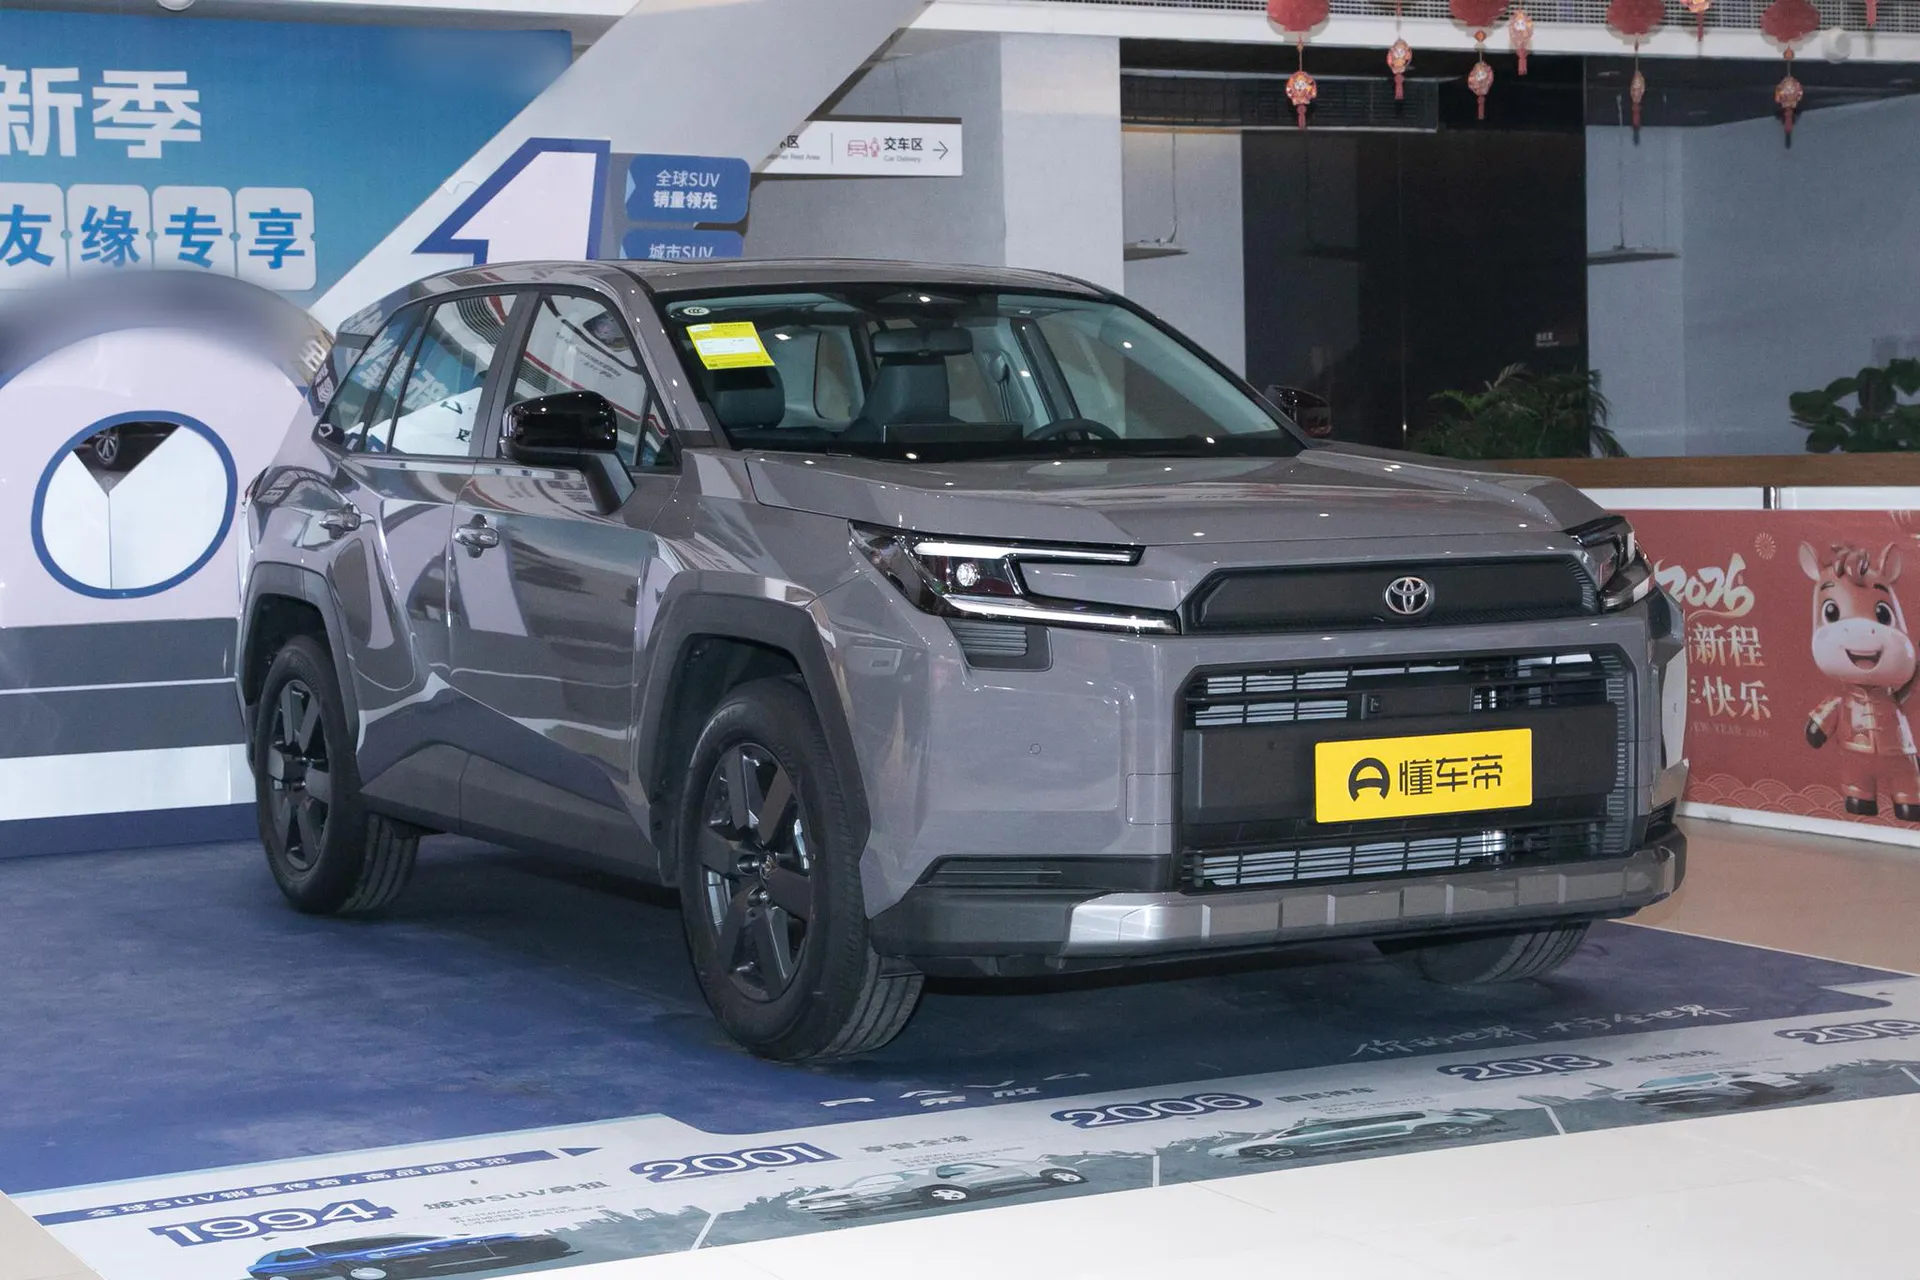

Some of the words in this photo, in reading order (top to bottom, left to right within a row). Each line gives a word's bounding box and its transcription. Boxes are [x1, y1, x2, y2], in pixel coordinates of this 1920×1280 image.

[0, 64, 202, 159] 新季
[884, 137, 923, 151] 交车区
[656, 170, 720, 188] 全球SUV
[653, 190, 718, 210] 销量领先
[0, 203, 306, 270] 友缘专享
[649, 243, 713, 259] 城市SUV
[1654, 553, 1755, 620] 2026
[1399, 754, 1503, 796] 懂车帝
[1449, 1054, 1601, 1082] 2013
[1064, 1092, 1252, 1128] 2006
[641, 1145, 826, 1180] 2001
[157, 1200, 381, 1246] 1994
